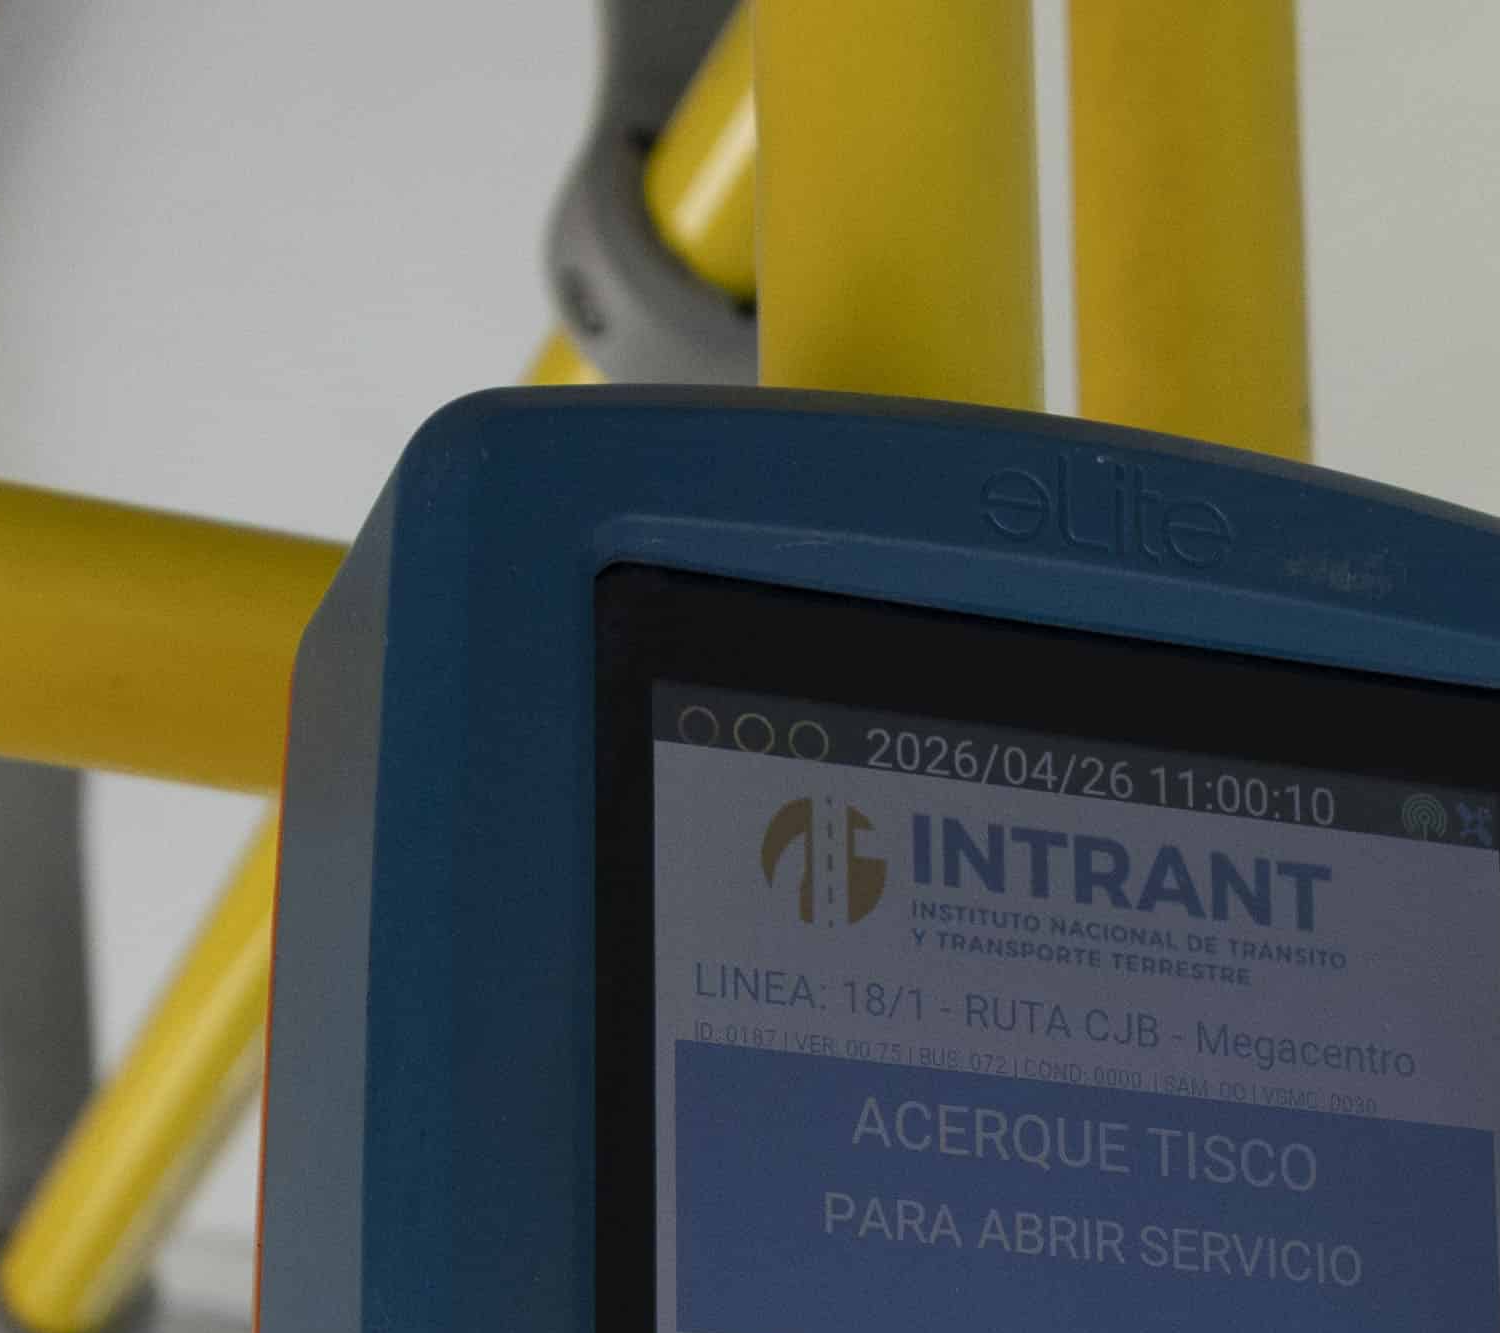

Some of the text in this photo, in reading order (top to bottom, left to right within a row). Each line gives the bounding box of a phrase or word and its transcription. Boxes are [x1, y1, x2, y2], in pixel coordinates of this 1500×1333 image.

[865, 726, 1335, 826] 2026/04/26 11:00:10
[911, 813, 1333, 932] INTRANT
[911, 901, 1041, 933] INSTITUTO
[1050, 917, 1179, 952] NACIONAL
[1187, 934, 1218, 955] DE
[912, 929, 1252, 986] Y TRANSPORTE TERRESTRE
[695, 961, 827, 1011] LINEA:
[843, 979, 923, 1021] 18/1
[964, 993, 1072, 1040] RUTA
[1084, 1008, 1160, 1048] CJB
[1195, 1020, 1416, 1078] Megacentro
[852, 1094, 1319, 1193] ACERQUE TISCO
[823, 1193, 1364, 1288] PARA ABRIR SERVICIO
